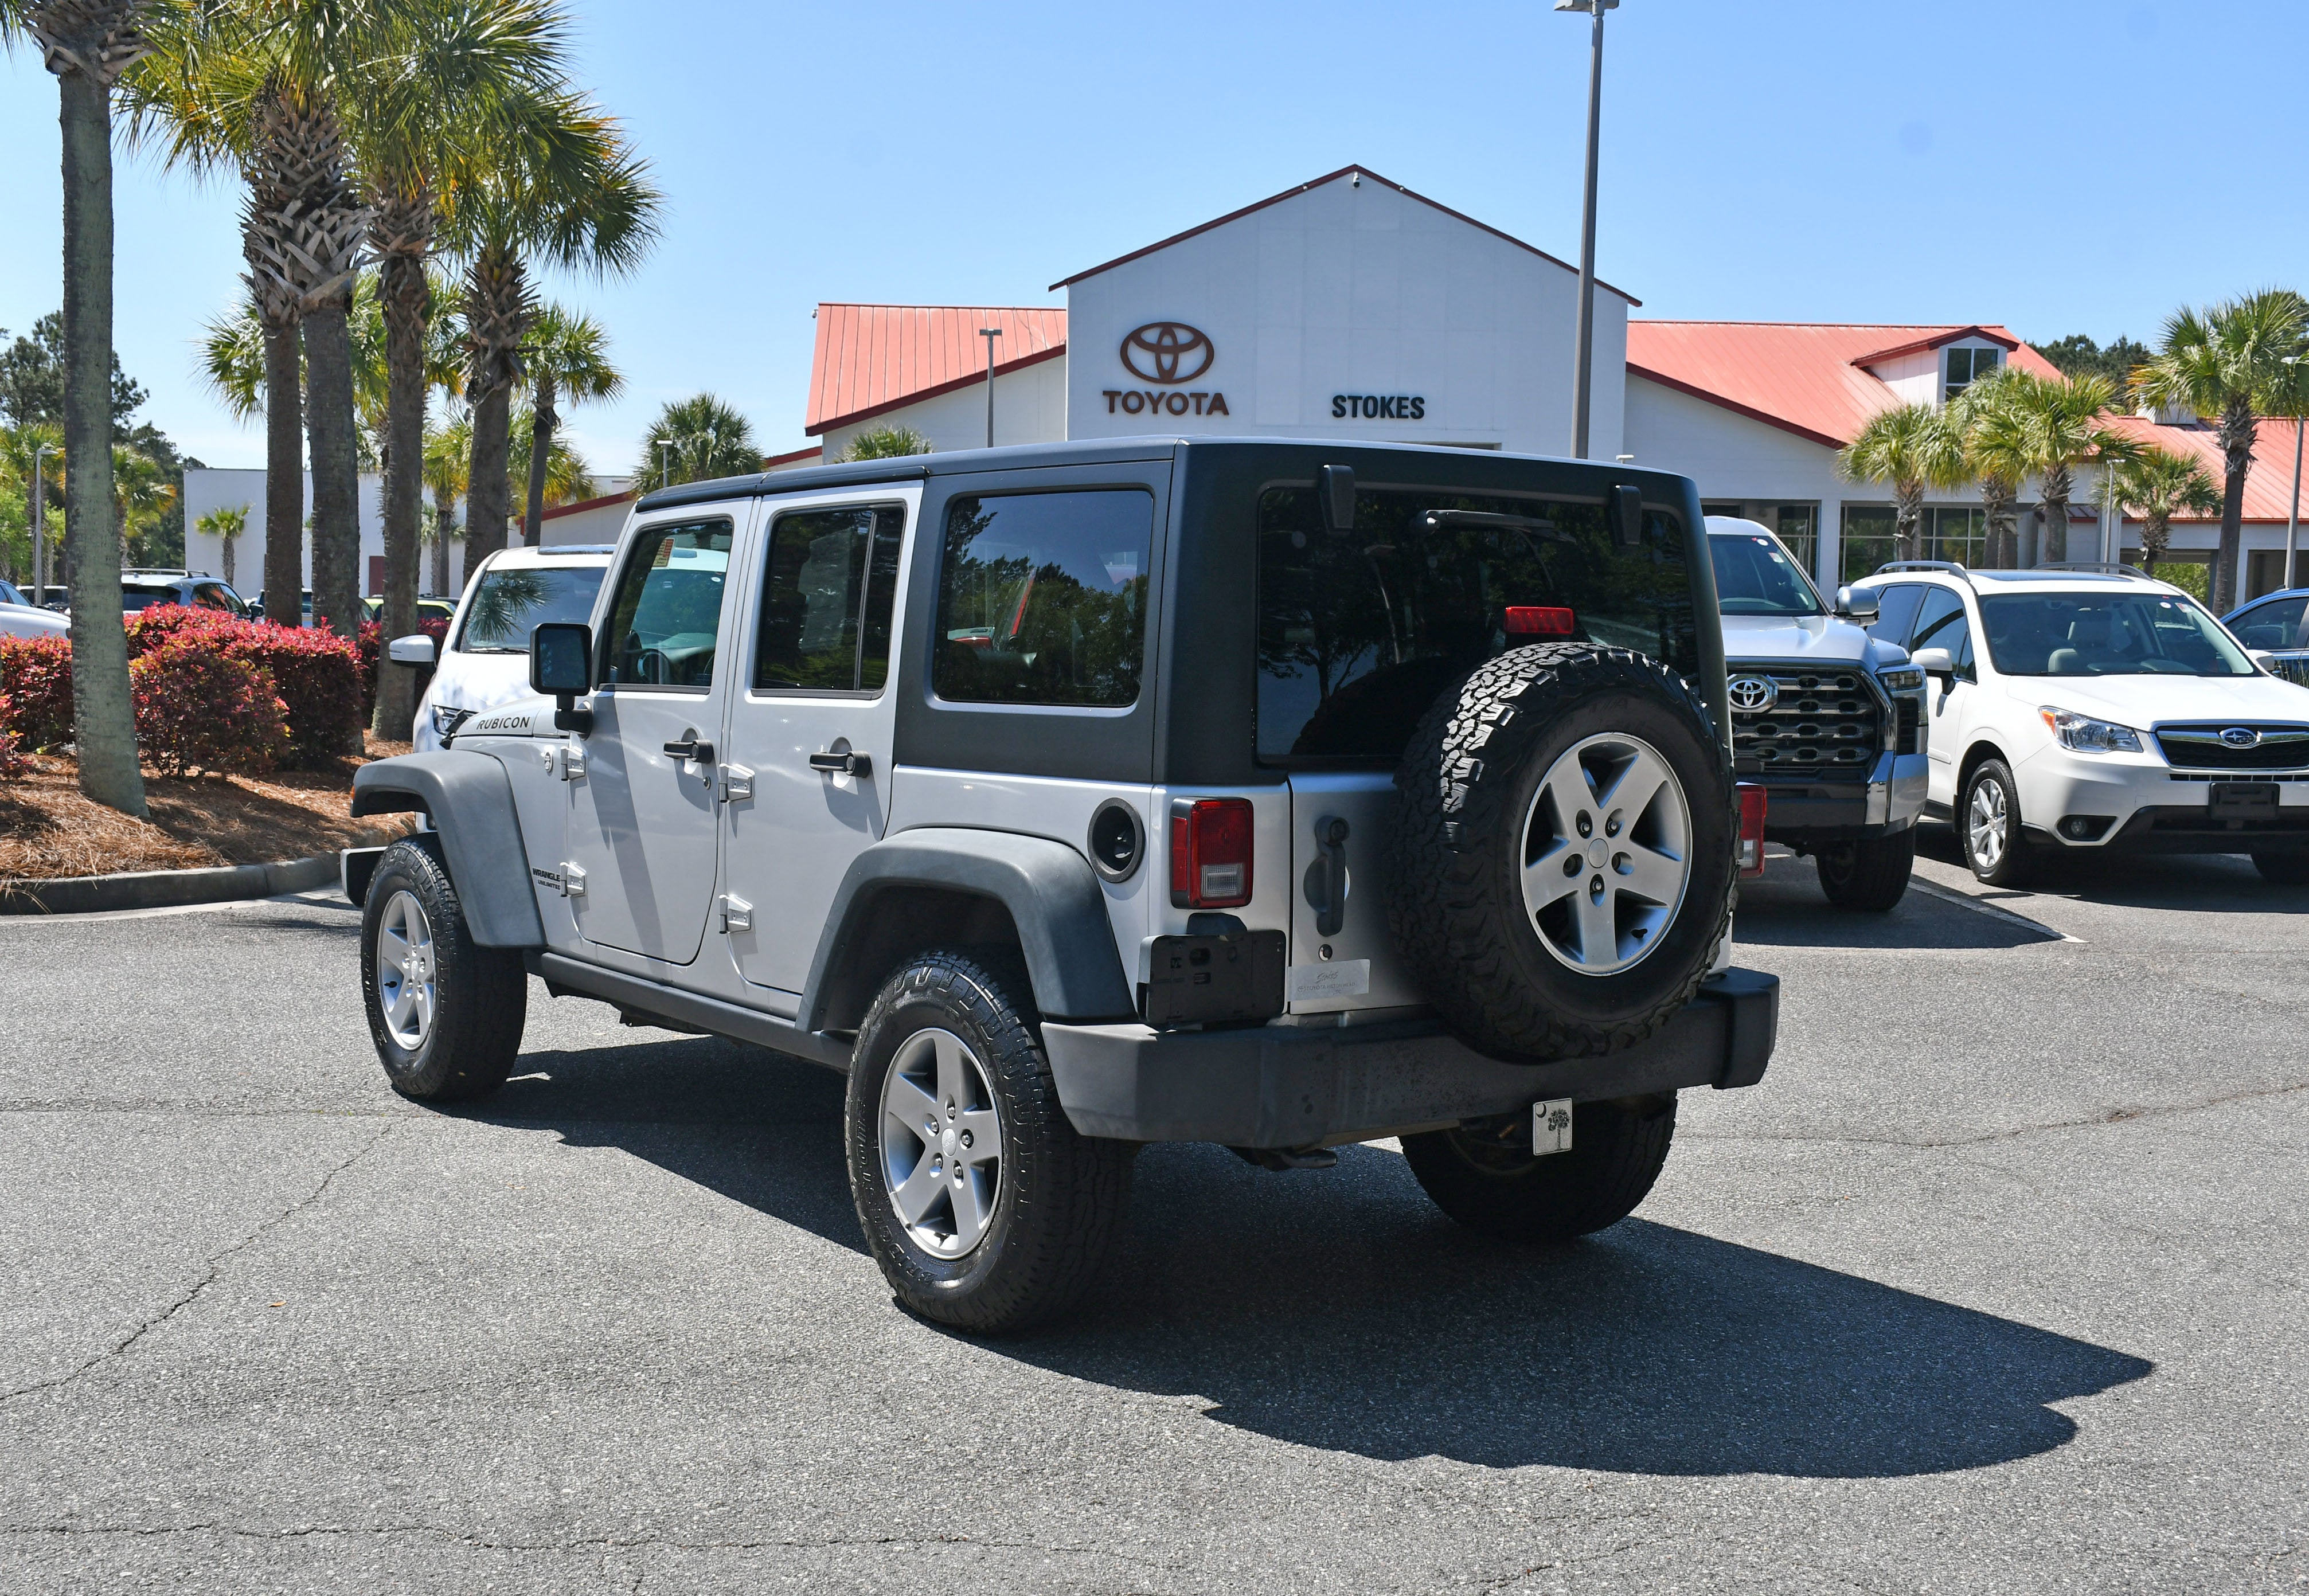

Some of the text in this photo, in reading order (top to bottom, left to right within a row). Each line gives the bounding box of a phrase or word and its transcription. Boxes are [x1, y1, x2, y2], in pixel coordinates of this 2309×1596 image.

[1103, 390, 1229, 416] TOYOTA
[1332, 394, 1425, 419] STOKES
[476, 716, 530, 730] RUBICON
[532, 868, 560, 881] WRANGLE
